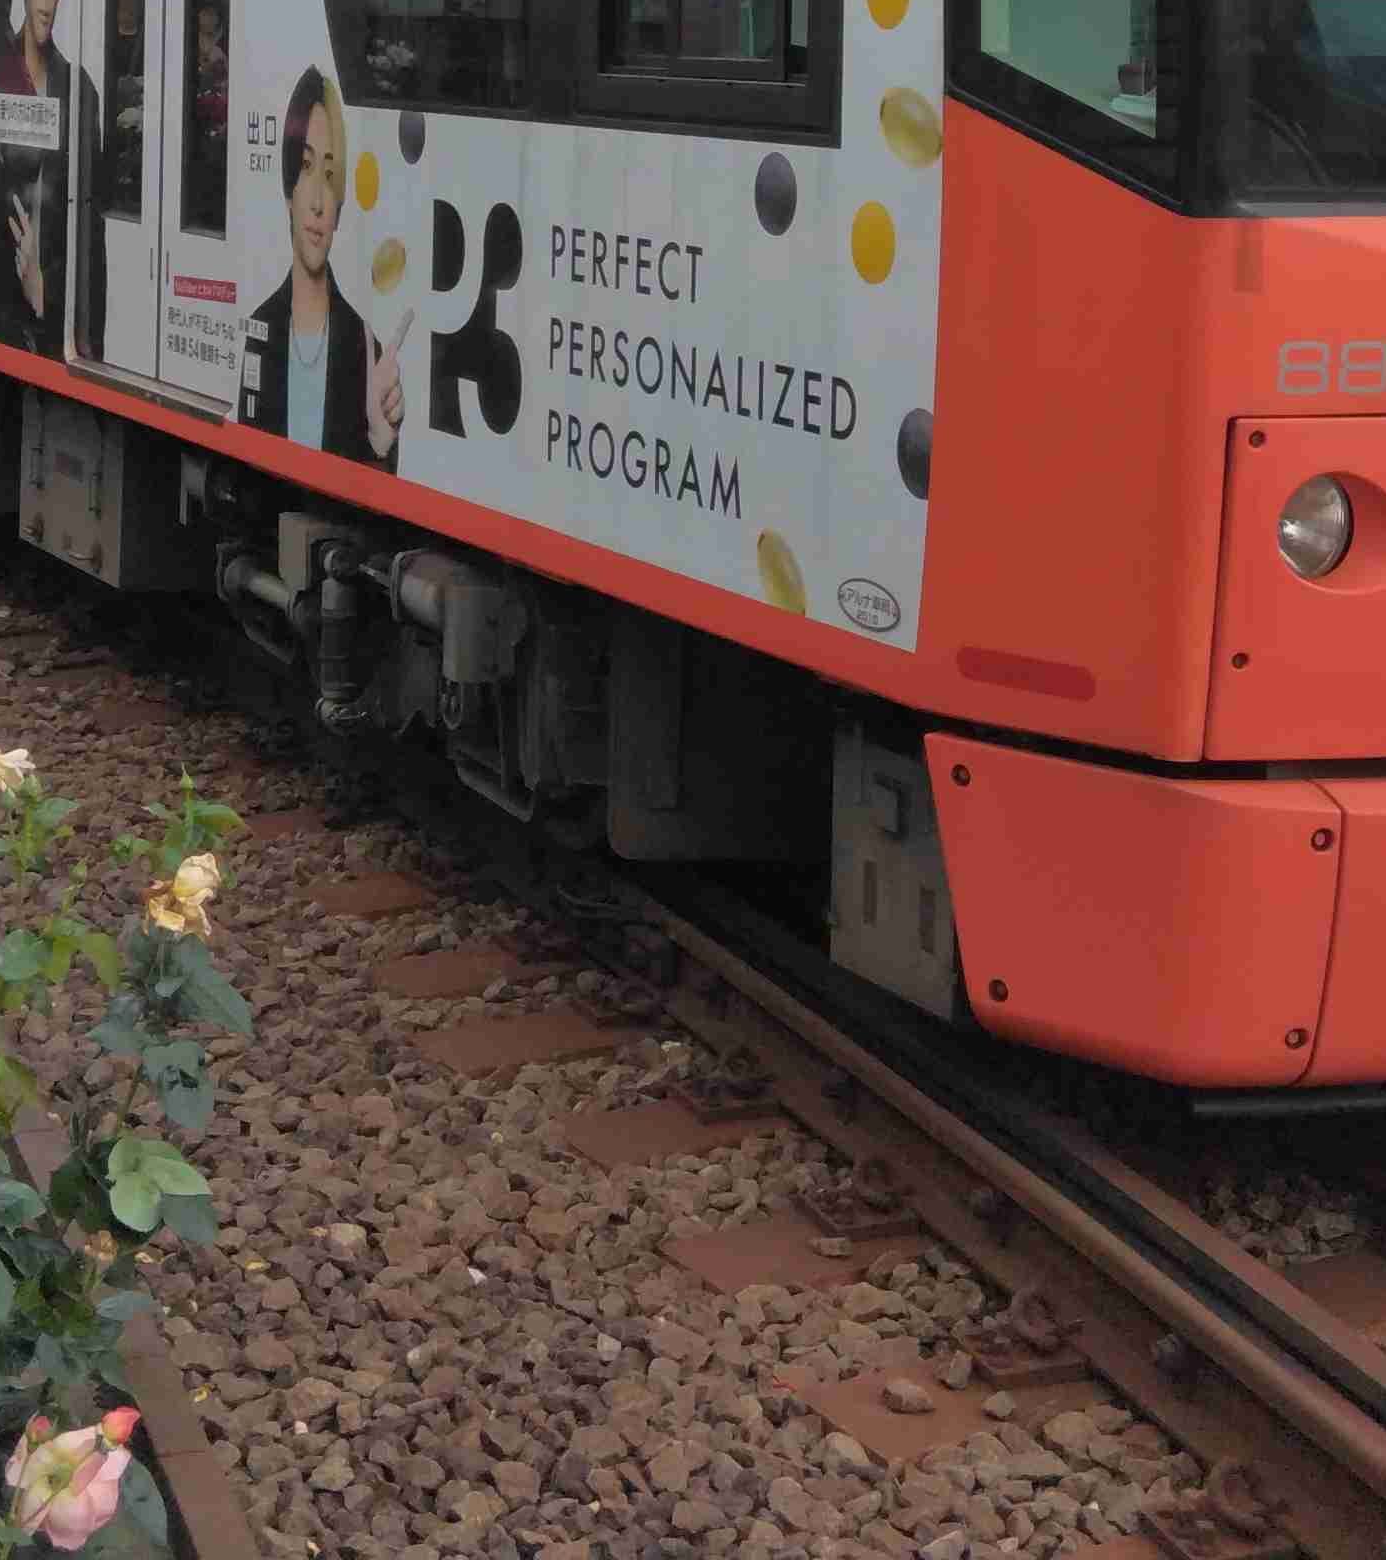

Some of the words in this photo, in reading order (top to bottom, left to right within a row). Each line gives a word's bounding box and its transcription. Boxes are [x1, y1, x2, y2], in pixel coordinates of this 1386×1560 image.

[247, 112, 276, 145] 出口
[250, 153, 270, 172] EXIT
[551, 224, 703, 304] PERFECT
[549, 317, 857, 440] PERSONALIZED
[547, 409, 741, 519] PROGRAM
